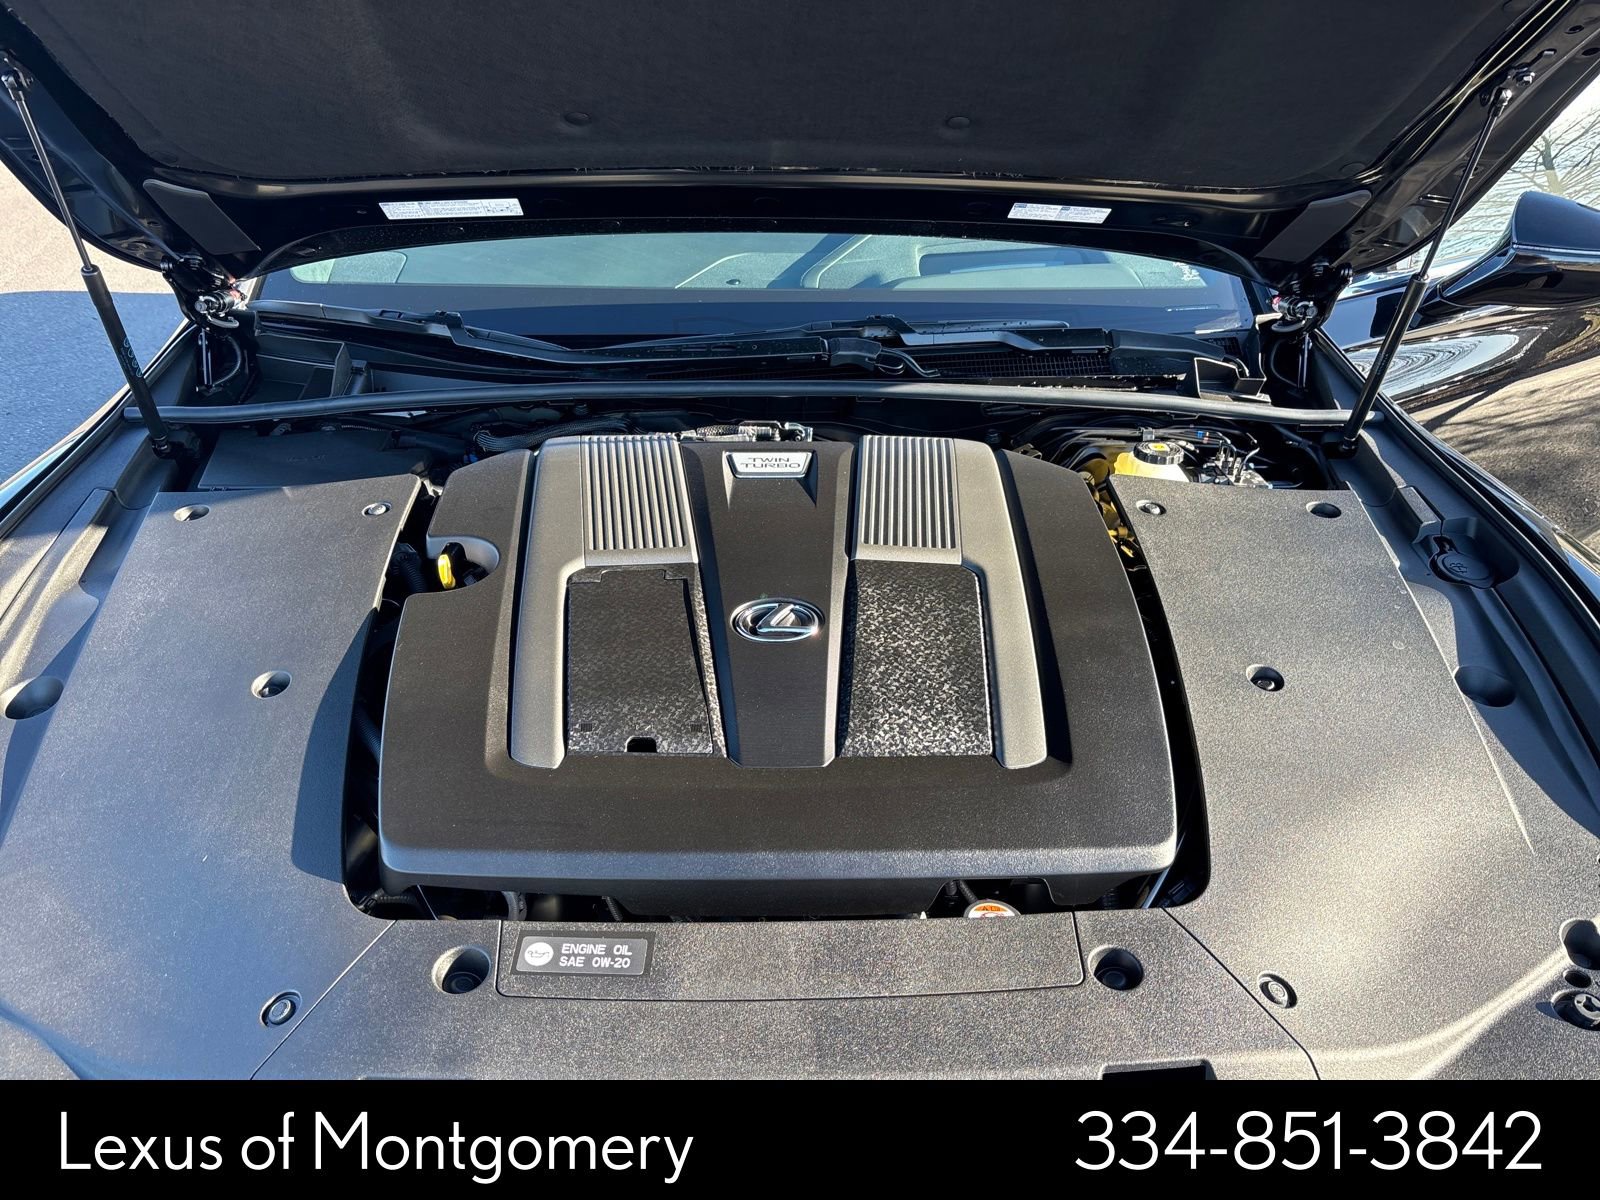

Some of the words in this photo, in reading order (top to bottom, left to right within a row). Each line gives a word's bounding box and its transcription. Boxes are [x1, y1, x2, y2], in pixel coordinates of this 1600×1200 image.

[561, 943, 607, 955] ENGINE
[613, 944, 633, 956] OIL
[559, 956, 586, 968] SAE
[591, 957, 631, 969] 0W-20
